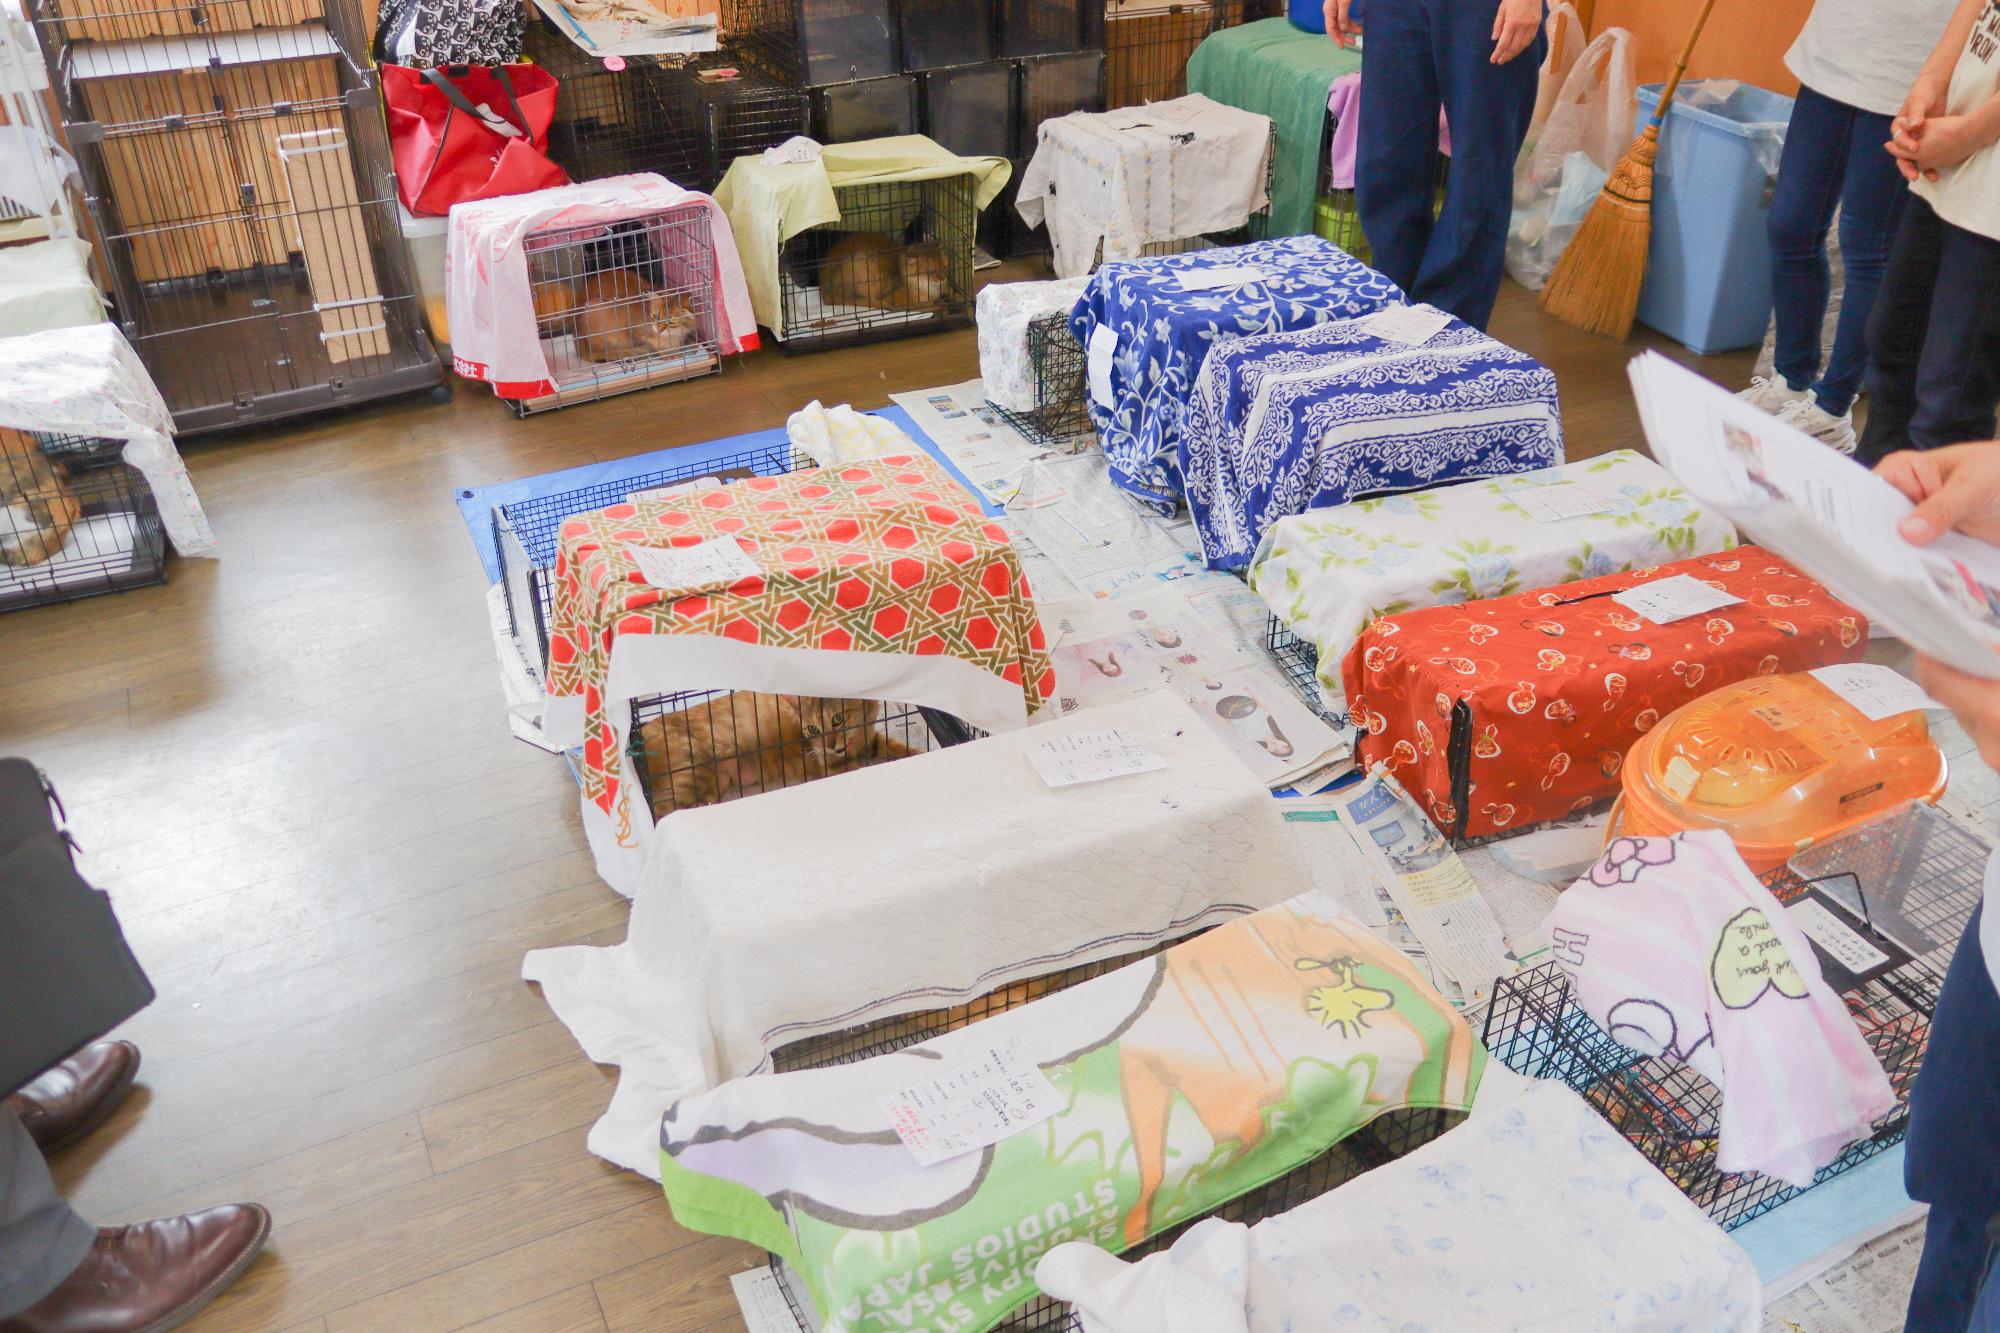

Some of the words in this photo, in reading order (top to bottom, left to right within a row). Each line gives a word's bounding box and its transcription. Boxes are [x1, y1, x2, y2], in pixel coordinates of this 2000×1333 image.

[1732, 921, 1771, 940] mile
[1753, 937, 1782, 956] eart
[1736, 959, 1770, 979] your
[951, 1177, 1117, 1271] STUDIOS
